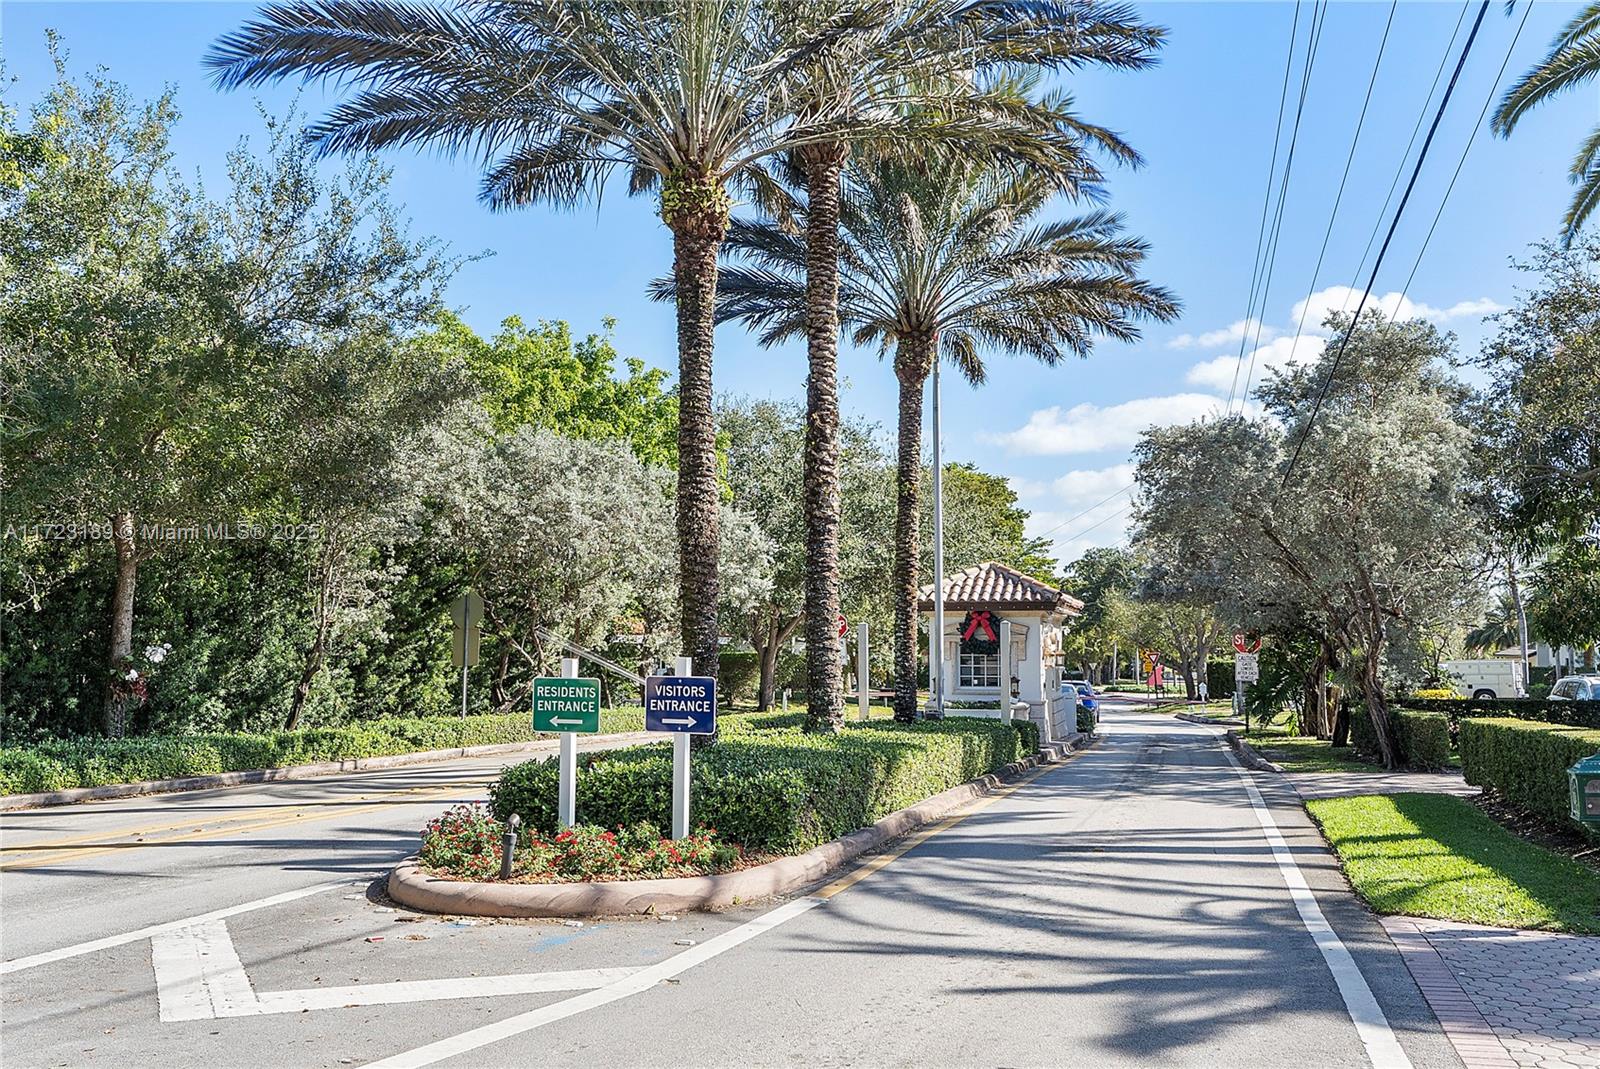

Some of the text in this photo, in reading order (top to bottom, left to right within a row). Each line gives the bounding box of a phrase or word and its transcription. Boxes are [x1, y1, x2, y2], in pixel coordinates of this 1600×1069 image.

[537, 686, 596, 698] RESIDENTS
[655, 685, 706, 698] VISITORS
[537, 700, 595, 713] ENTRANCE
[650, 699, 711, 713] ENTRANCE
